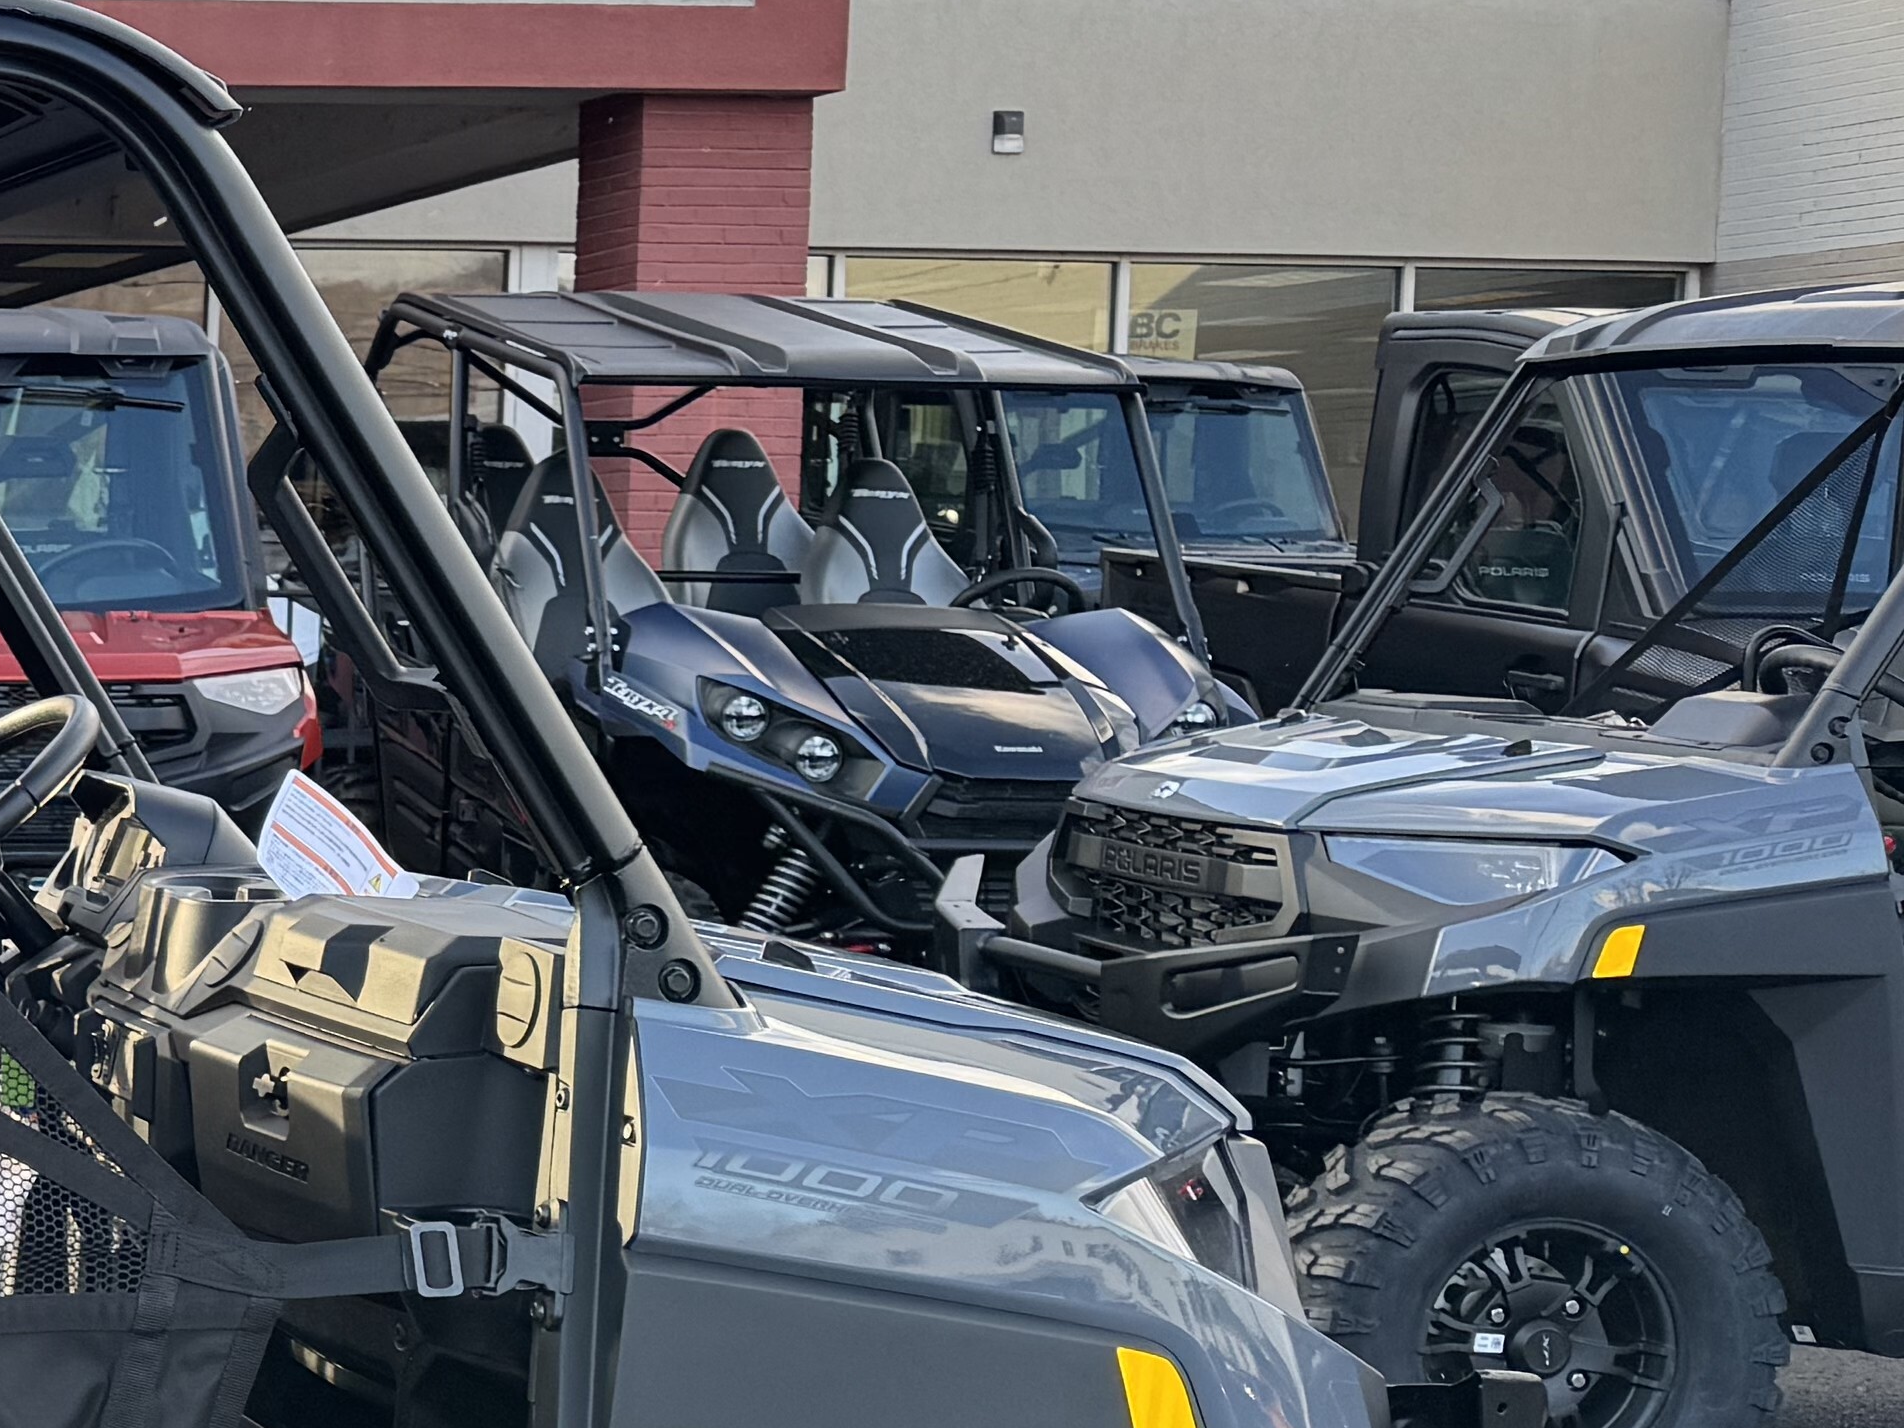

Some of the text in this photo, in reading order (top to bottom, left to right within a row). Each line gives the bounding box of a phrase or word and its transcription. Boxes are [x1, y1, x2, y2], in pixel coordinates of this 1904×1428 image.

[1479, 565, 1550, 578] POLARIS
[1101, 843, 1202, 886] POLARIS
[226, 1132, 310, 1184] RANGER
